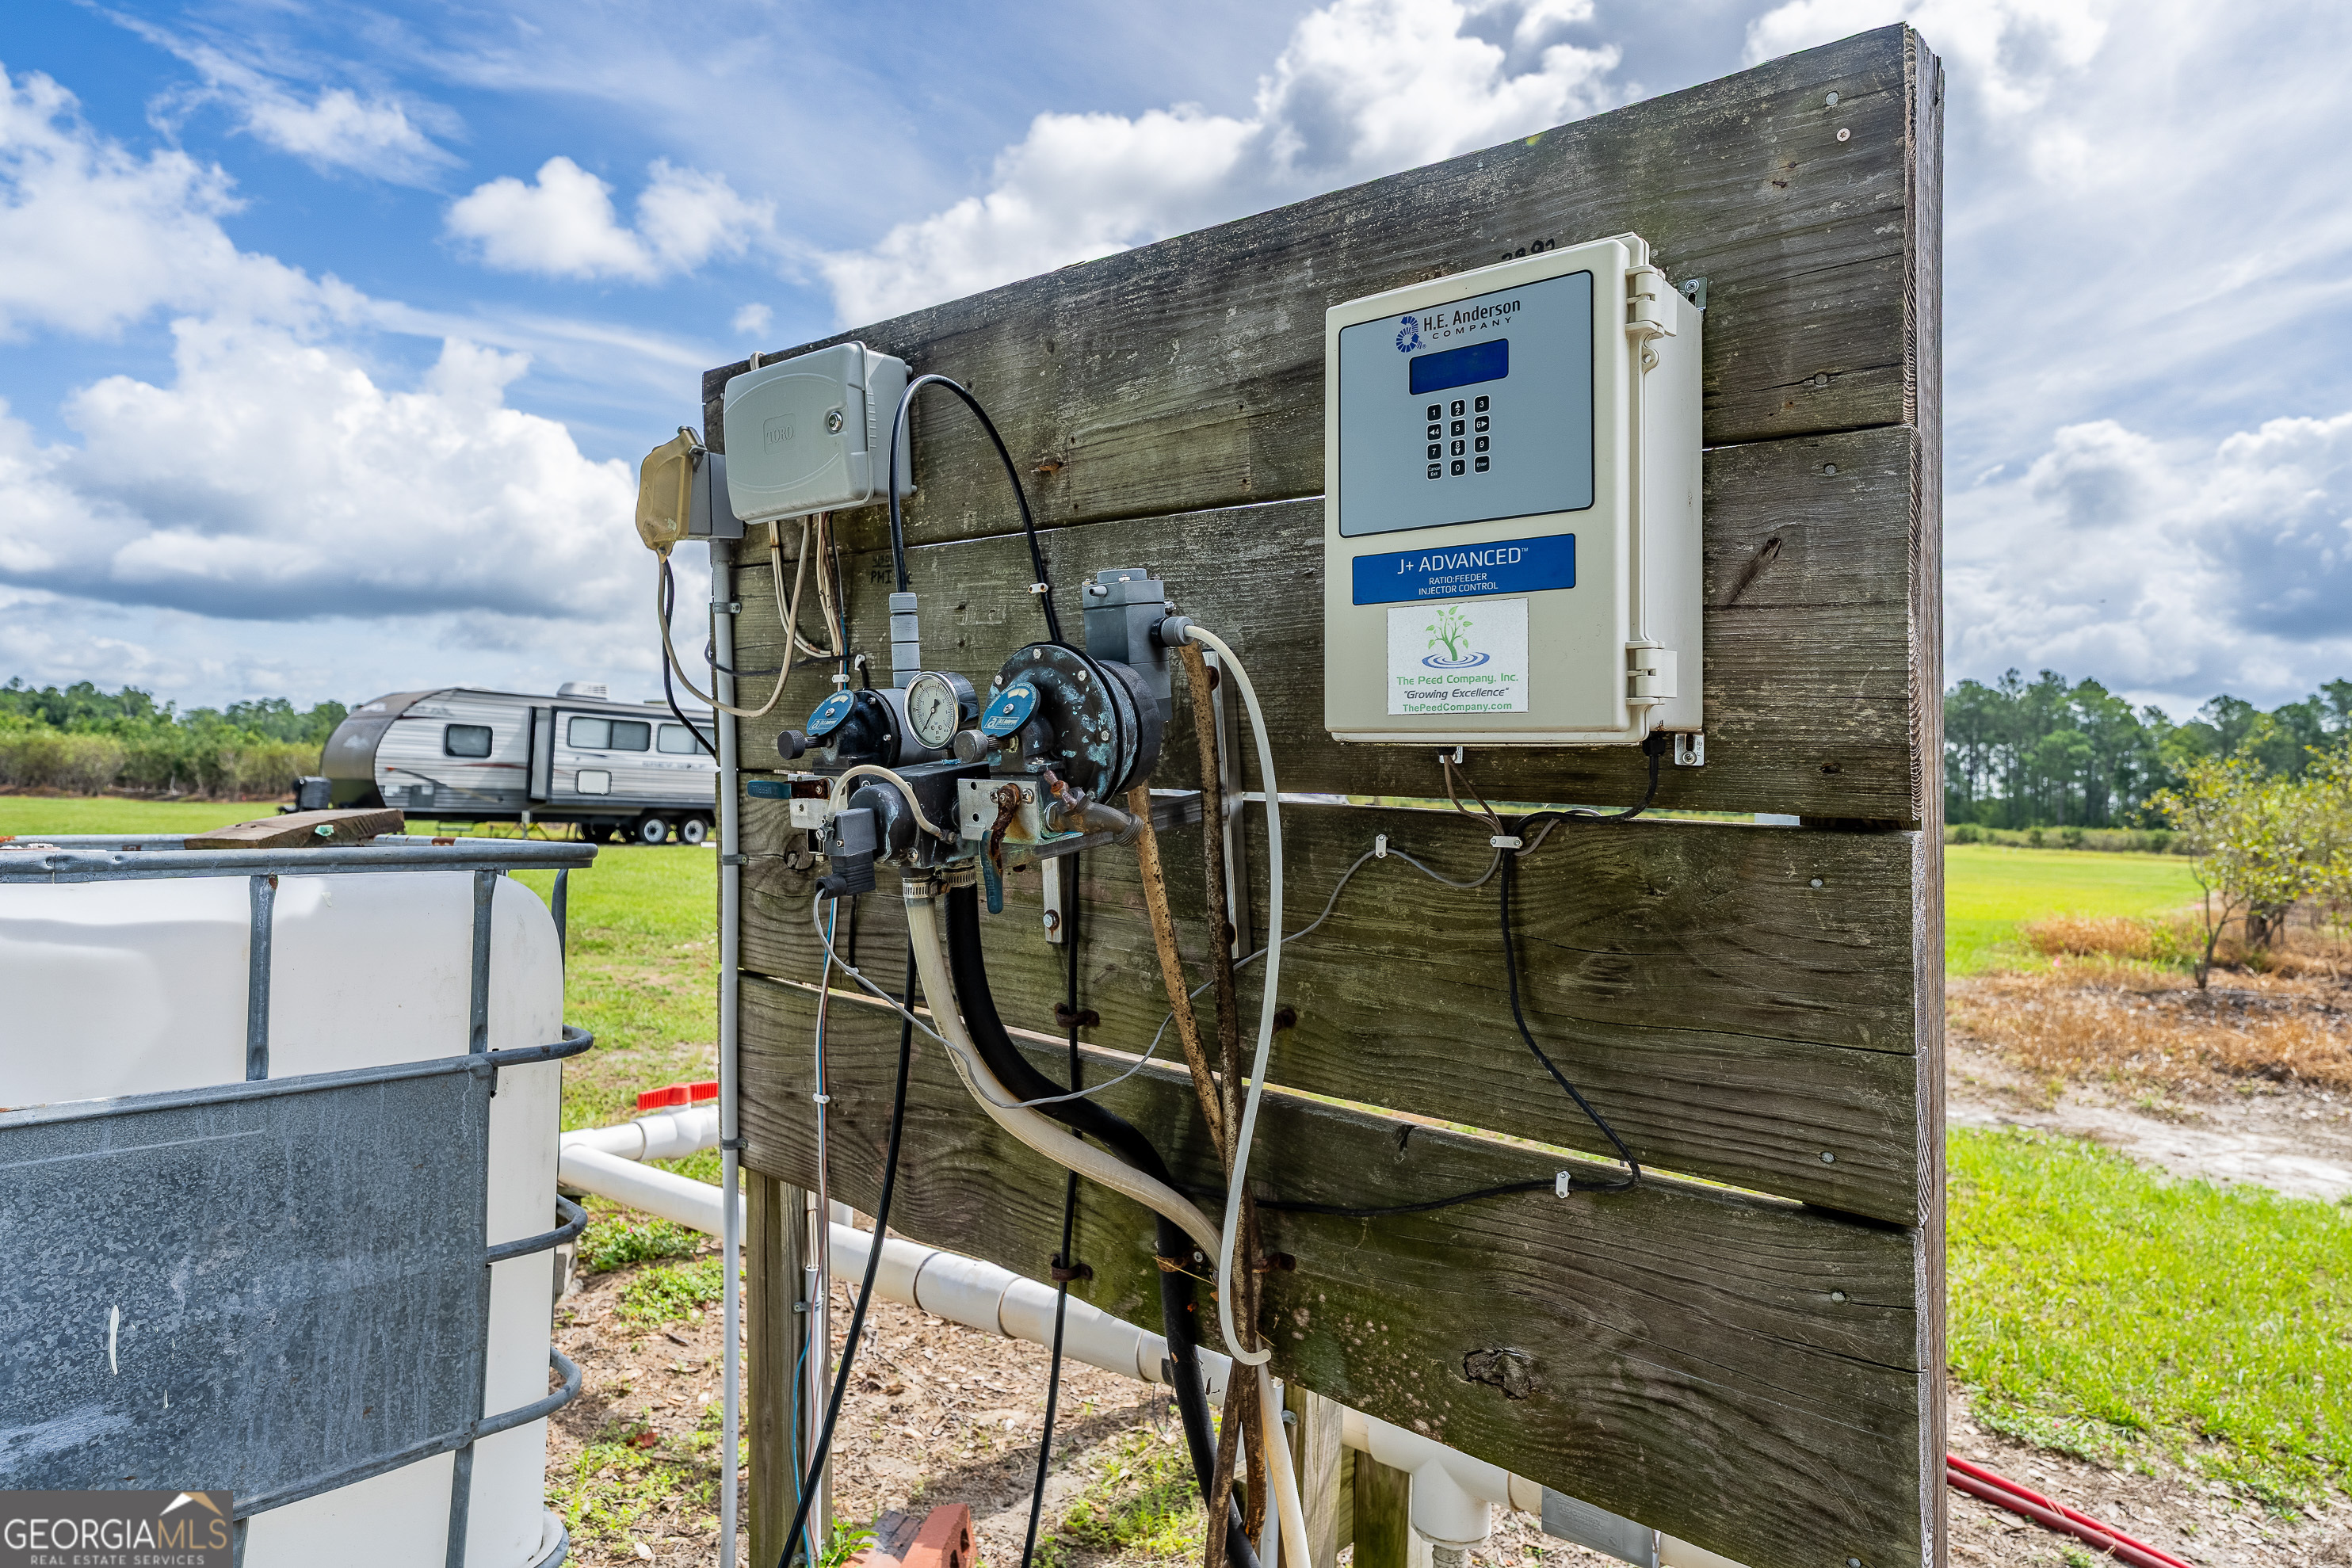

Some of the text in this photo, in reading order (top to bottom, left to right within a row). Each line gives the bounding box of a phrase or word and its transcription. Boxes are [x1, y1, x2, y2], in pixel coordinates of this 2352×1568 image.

[1423, 299, 1521, 332] H.E. Anderson
[1432, 316, 1512, 339] COMPANY
[766, 425, 794, 444] TORO
[1397, 559, 1415, 574] J+
[1429, 572, 1487, 586] RATIO:FEEDER
[1418, 582, 1499, 595] INJECTOR CONTROL
[1396, 677, 1415, 685] The
[1418, 674, 1443, 685] Peed
[1500, 673, 1519, 682] Inc.
[1403, 703, 1513, 712] ThePeedCompany.com
[983, 860, 995, 901] MERRILL
